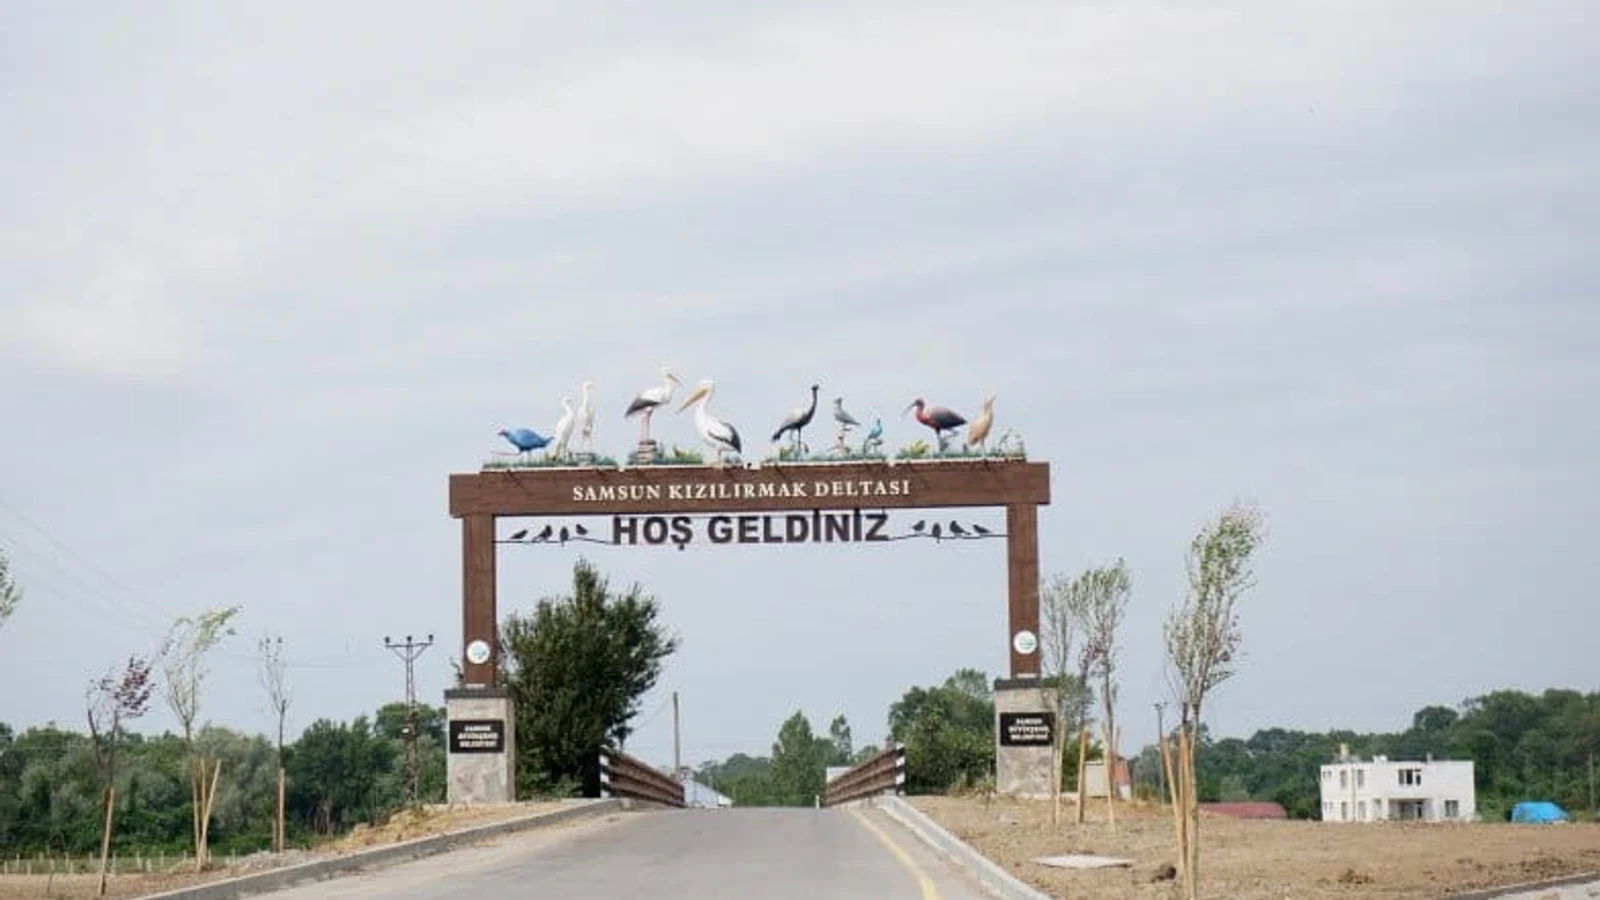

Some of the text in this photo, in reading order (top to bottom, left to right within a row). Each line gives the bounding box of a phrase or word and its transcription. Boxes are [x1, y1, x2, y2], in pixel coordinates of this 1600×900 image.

[573, 479, 910, 501] SAMSUN KIZILIRMAK DELTASI
[613, 508, 889, 551] HOŞ GELDİNİZ
